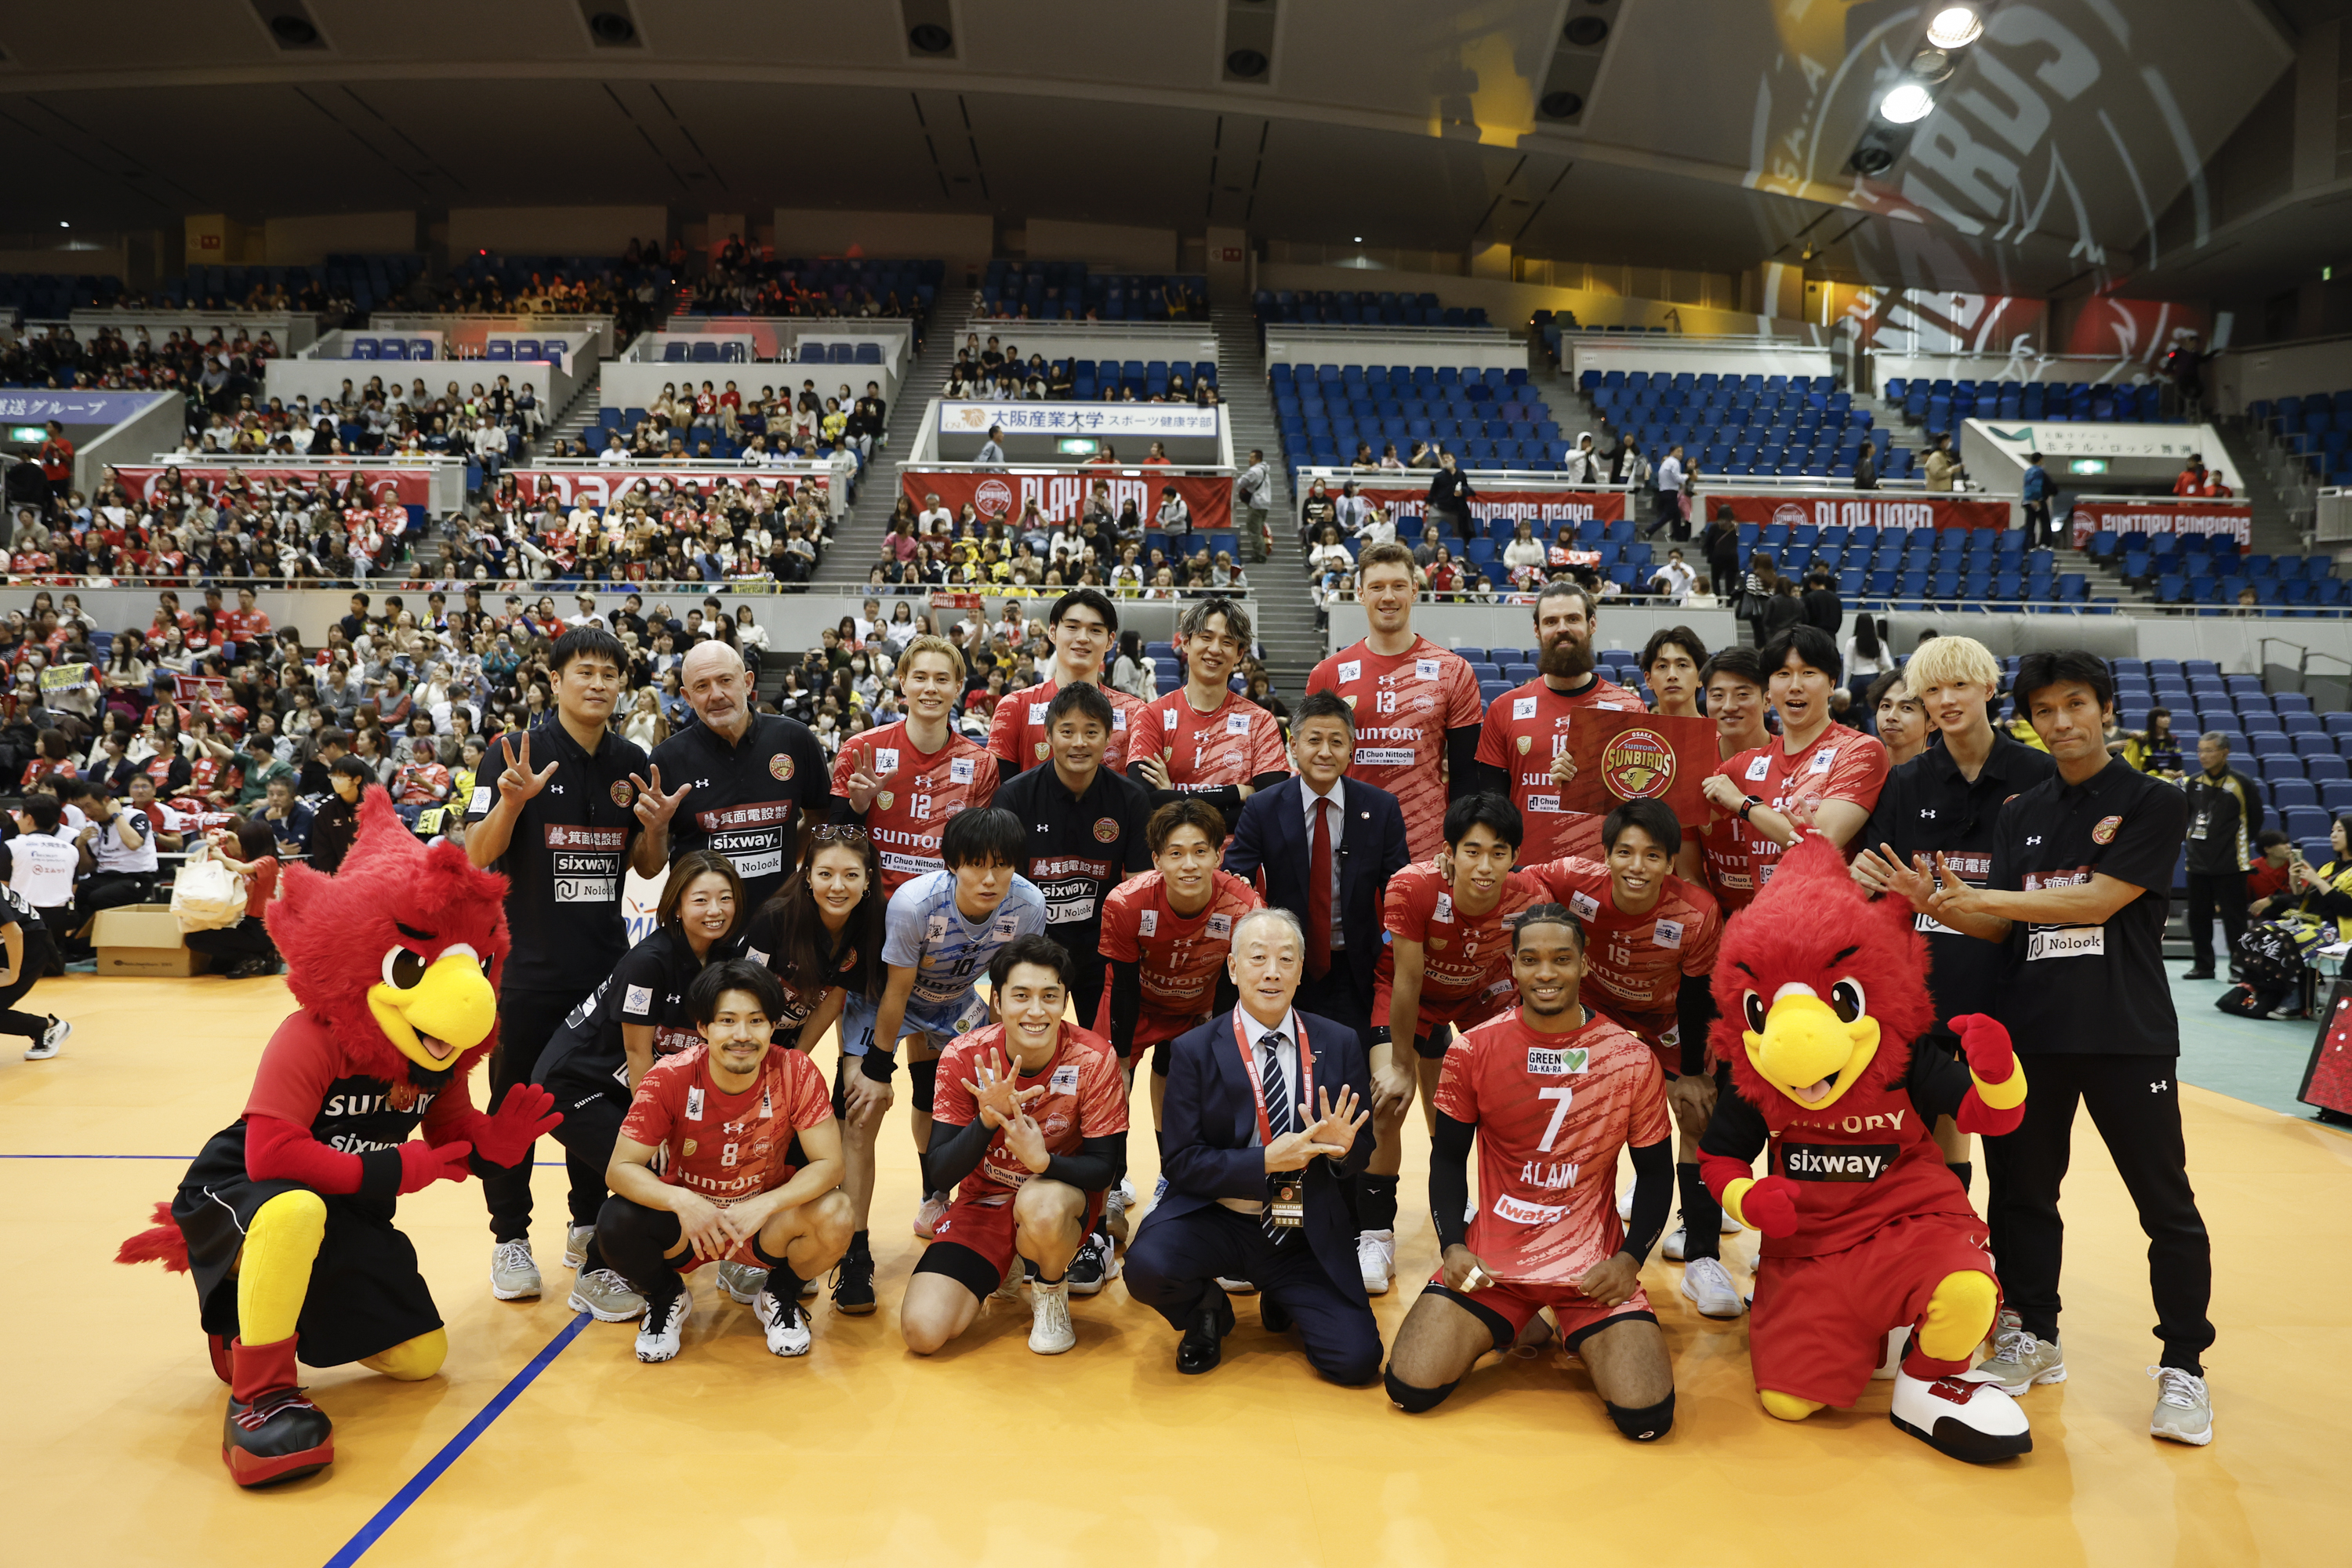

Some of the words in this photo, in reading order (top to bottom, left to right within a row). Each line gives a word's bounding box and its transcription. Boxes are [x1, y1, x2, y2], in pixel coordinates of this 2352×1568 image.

[991, 410, 1104, 429] 大阪産業大学
[1109, 415, 1212, 428] スポーツ健康学部
[1021, 477, 1080, 521] PLAY
[1468, 502, 1538, 528] UNBIRDS
[1376, 691, 1396, 713] 13
[1355, 728, 1425, 741] UNTORY
[1624, 742, 1657, 751] SUNTORY
[1194, 746, 1203, 768] 1
[1606, 749, 1671, 778] SUNBIRDS
[909, 793, 932, 819] 12
[720, 808, 775, 825] 箕面電設
[568, 830, 612, 846] 箕面電設
[713, 833, 775, 850] sixway
[873, 827, 942, 849] SUNTO
[558, 855, 612, 873] sixway
[742, 858, 779, 873] Nolook
[894, 856, 913, 866] Chuo
[915, 859, 944, 869] Nittochi
[1708, 848, 1748, 866] SUNT
[1051, 859, 1092, 874] 箕面電設
[583, 886, 614, 895] Nolook
[1042, 883, 1089, 897] sixway
[1064, 905, 1091, 917] Nolook
[1003, 924, 1011, 934] 生
[1214, 922, 1222, 931] 生
[1664, 928, 1672, 939] 生
[1463, 942, 1479, 958] 9
[2049, 935, 2101, 950] Nolook
[1169, 952, 1189, 969] 11
[1608, 943, 1630, 966] 15
[949, 958, 975, 976] 10
[1588, 956, 1662, 988] UNTORY
[917, 975, 968, 990] UNTO
[1141, 966, 1216, 986] UNTORY
[1150, 984, 1169, 994] Chuo
[1493, 984, 1513, 993] つの食
[1618, 987, 1651, 998] Nittochi
[1529, 1052, 1561, 1065] GREEN
[1536, 1087, 1573, 1152] 7
[328, 1133, 407, 1155] sixw
[721, 1143, 739, 1166] 8
[1789, 1149, 1882, 1178] sixway
[678, 1166, 765, 1191] SUNTOR
[993, 1168, 1013, 1180] Chuo
[1519, 1160, 1579, 1189] ALAIN
[725, 1189, 760, 1203] Nittochi
[1497, 1199, 1559, 1221] Iwata
